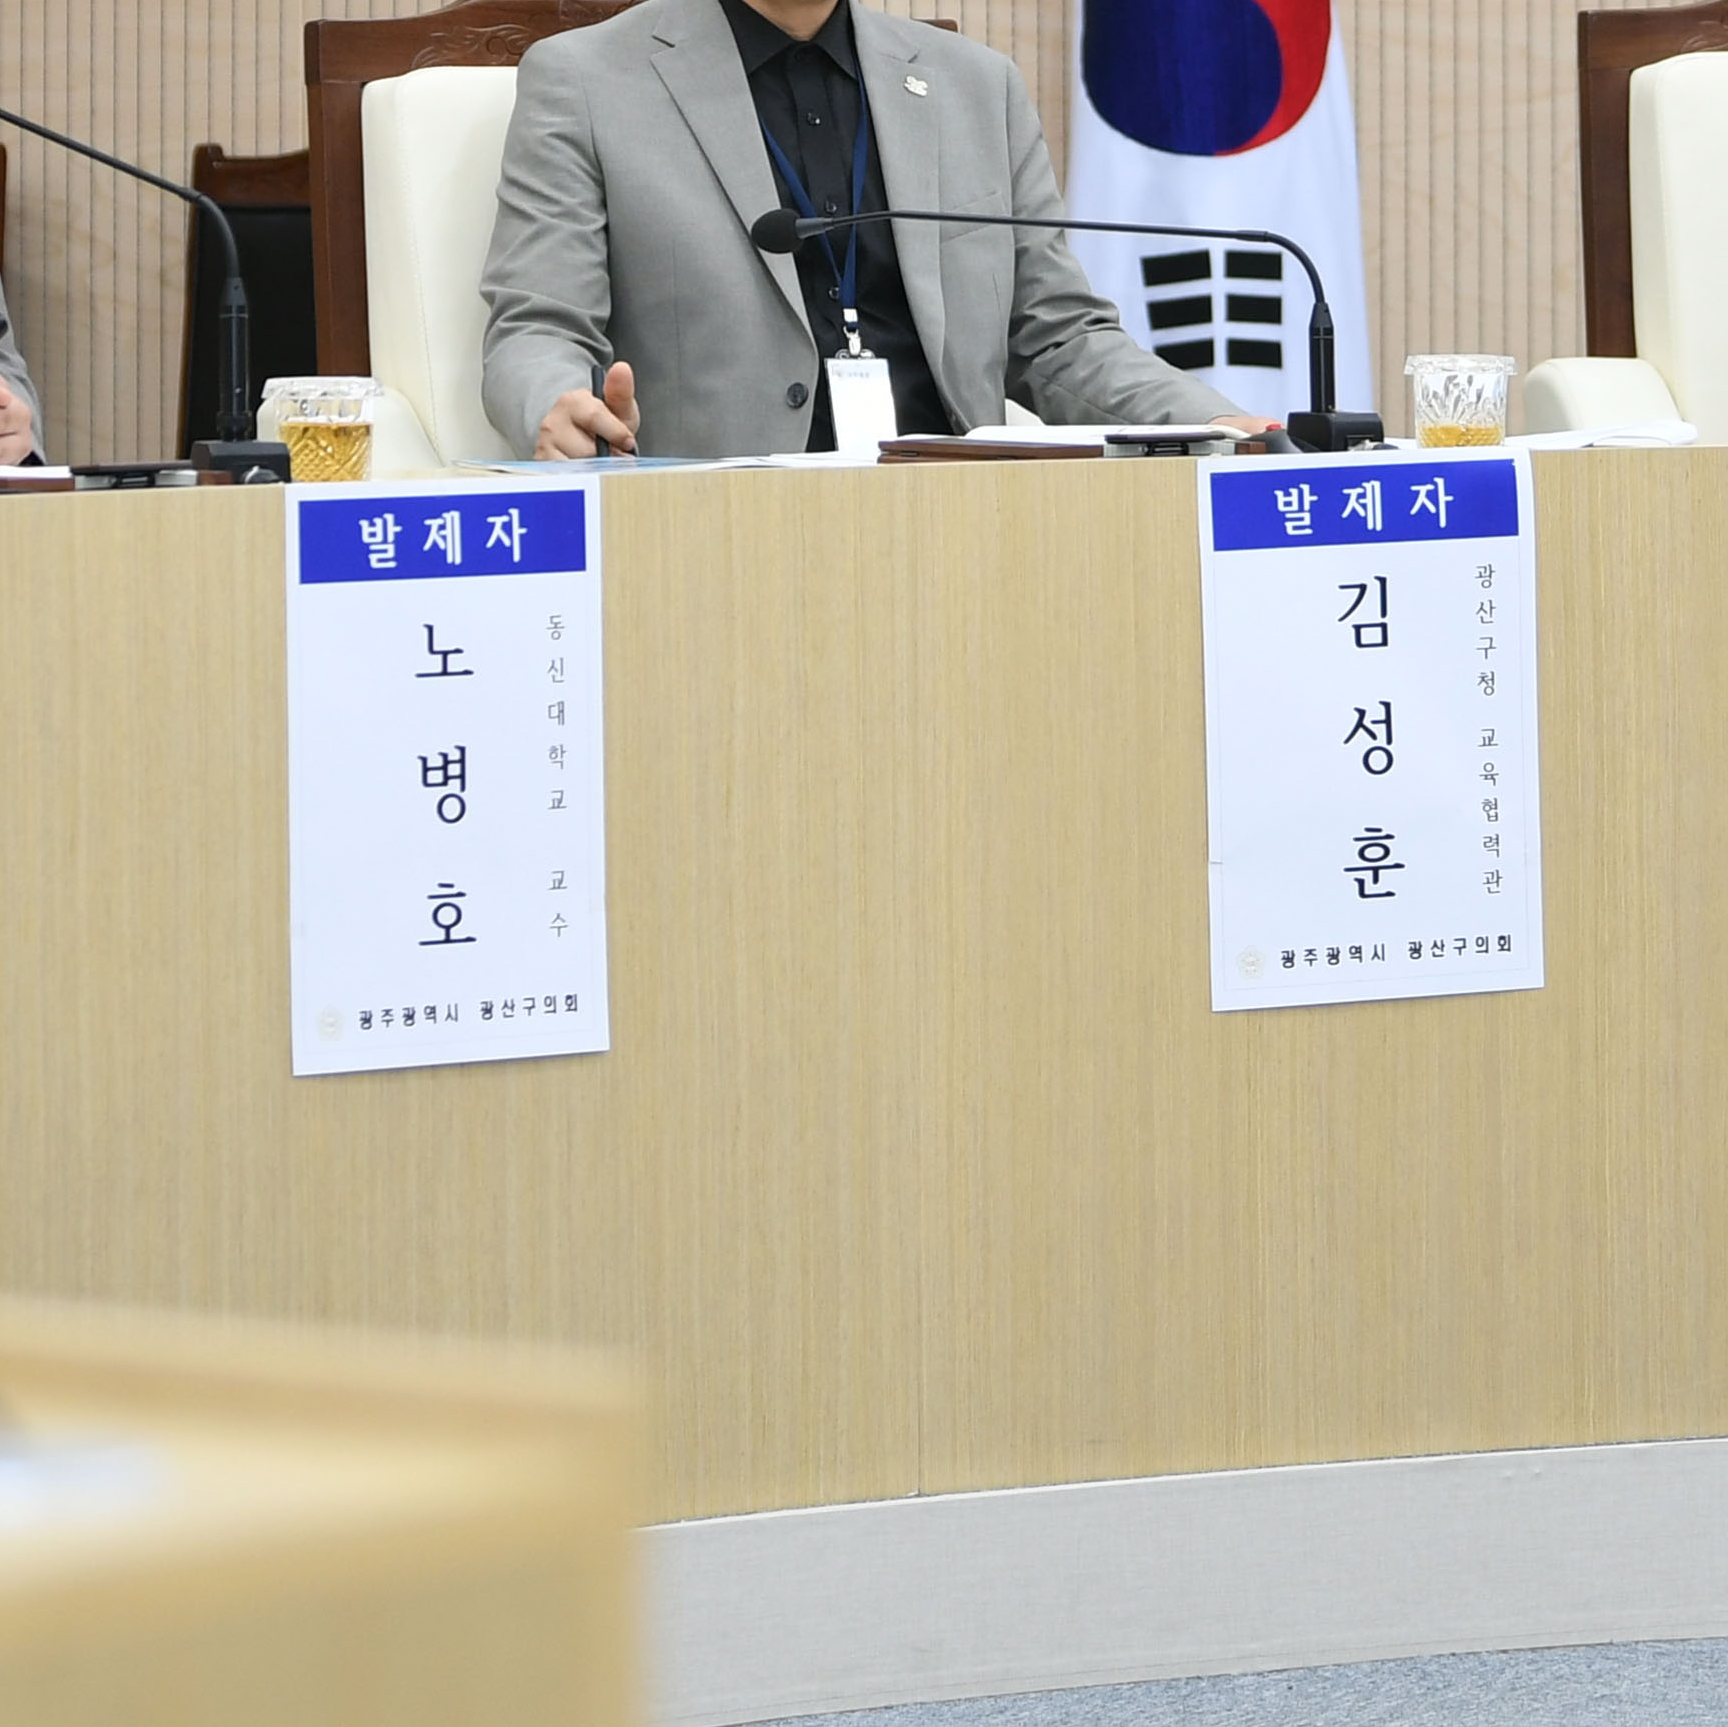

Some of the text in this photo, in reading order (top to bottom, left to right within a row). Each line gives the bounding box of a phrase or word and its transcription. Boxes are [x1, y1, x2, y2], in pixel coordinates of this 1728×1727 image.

[357, 506, 529, 570] 발제자
[1272, 476, 1455, 537] 발제자
[414, 622, 478, 947] 노병호
[545, 613, 570, 939] 동신대학교 교수
[1336, 574, 1407, 900] 김성훈
[1474, 562, 1504, 895] 광산구청 교육협력관
[358, 992, 579, 1032] 광주광역시 광산구의회
[1280, 933, 1513, 970] 광주광역시 광산구의회
